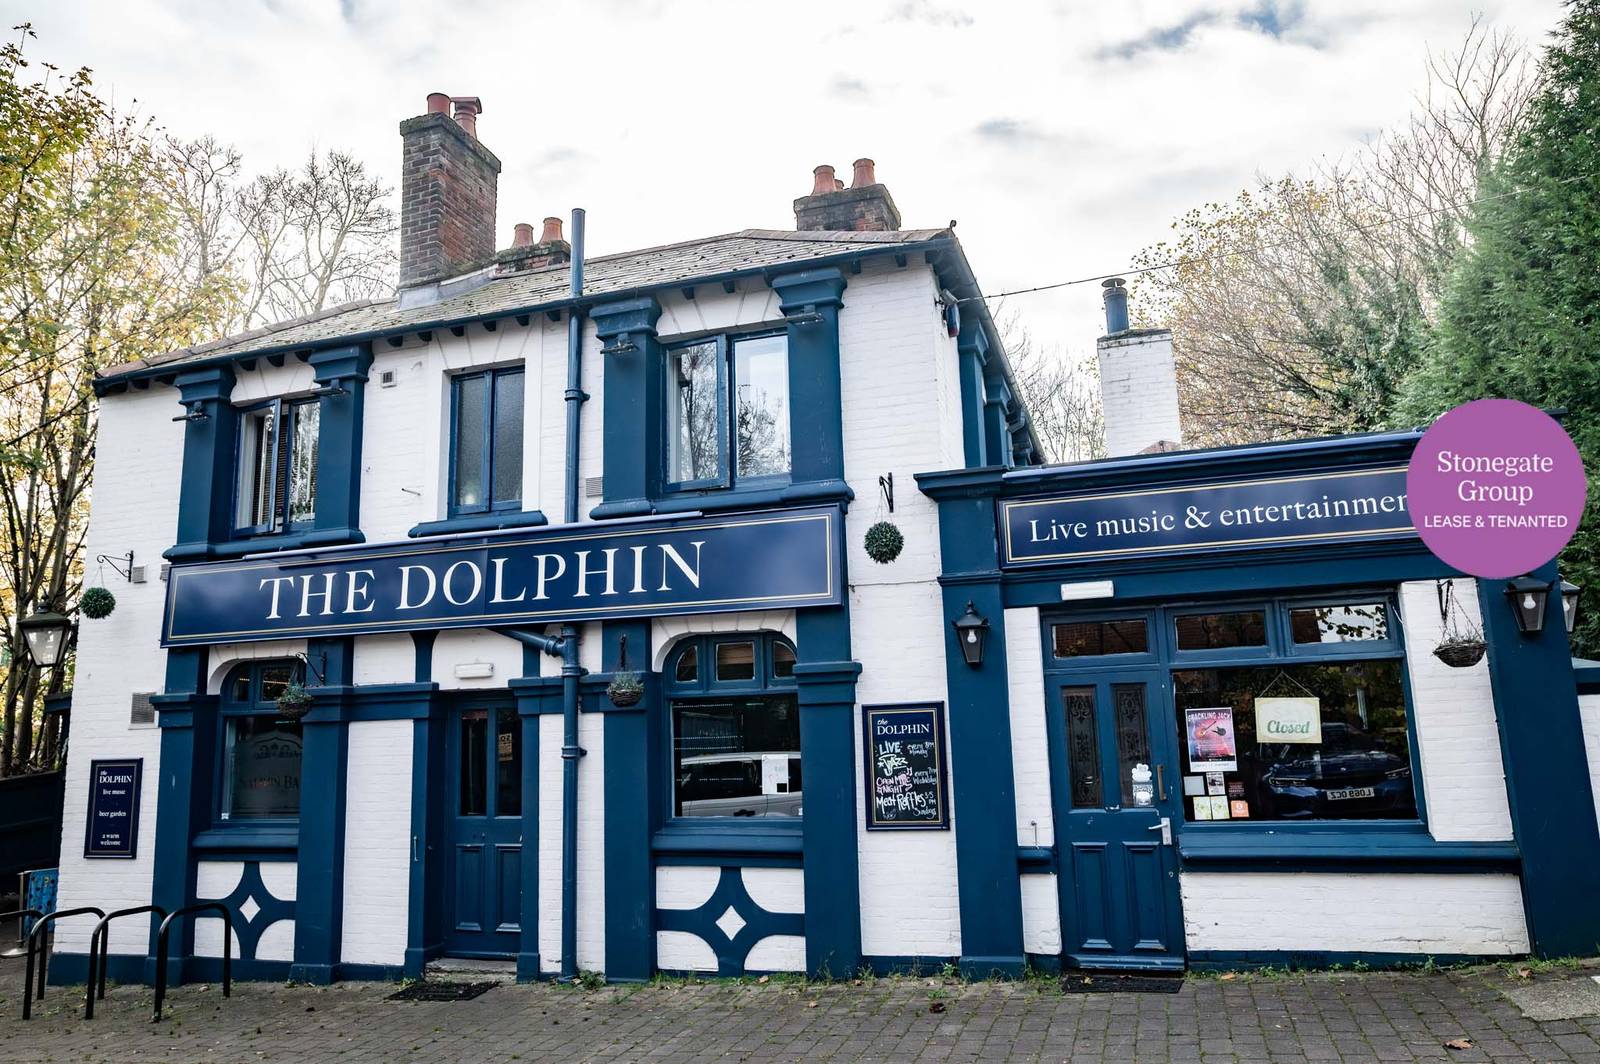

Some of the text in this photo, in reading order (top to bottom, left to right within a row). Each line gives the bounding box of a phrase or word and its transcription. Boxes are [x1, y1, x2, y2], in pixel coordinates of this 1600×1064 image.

[1030, 495, 1408, 542] Live music & entertainme
[259, 541, 706, 619] THE DOLPHIN
[877, 724, 930, 736] DOLPHIN
[1266, 719, 1311, 734] Closed
[879, 741, 901, 755] LIVE
[99, 775, 133, 784] DOLPHIN
[109, 810, 127, 818] garden
